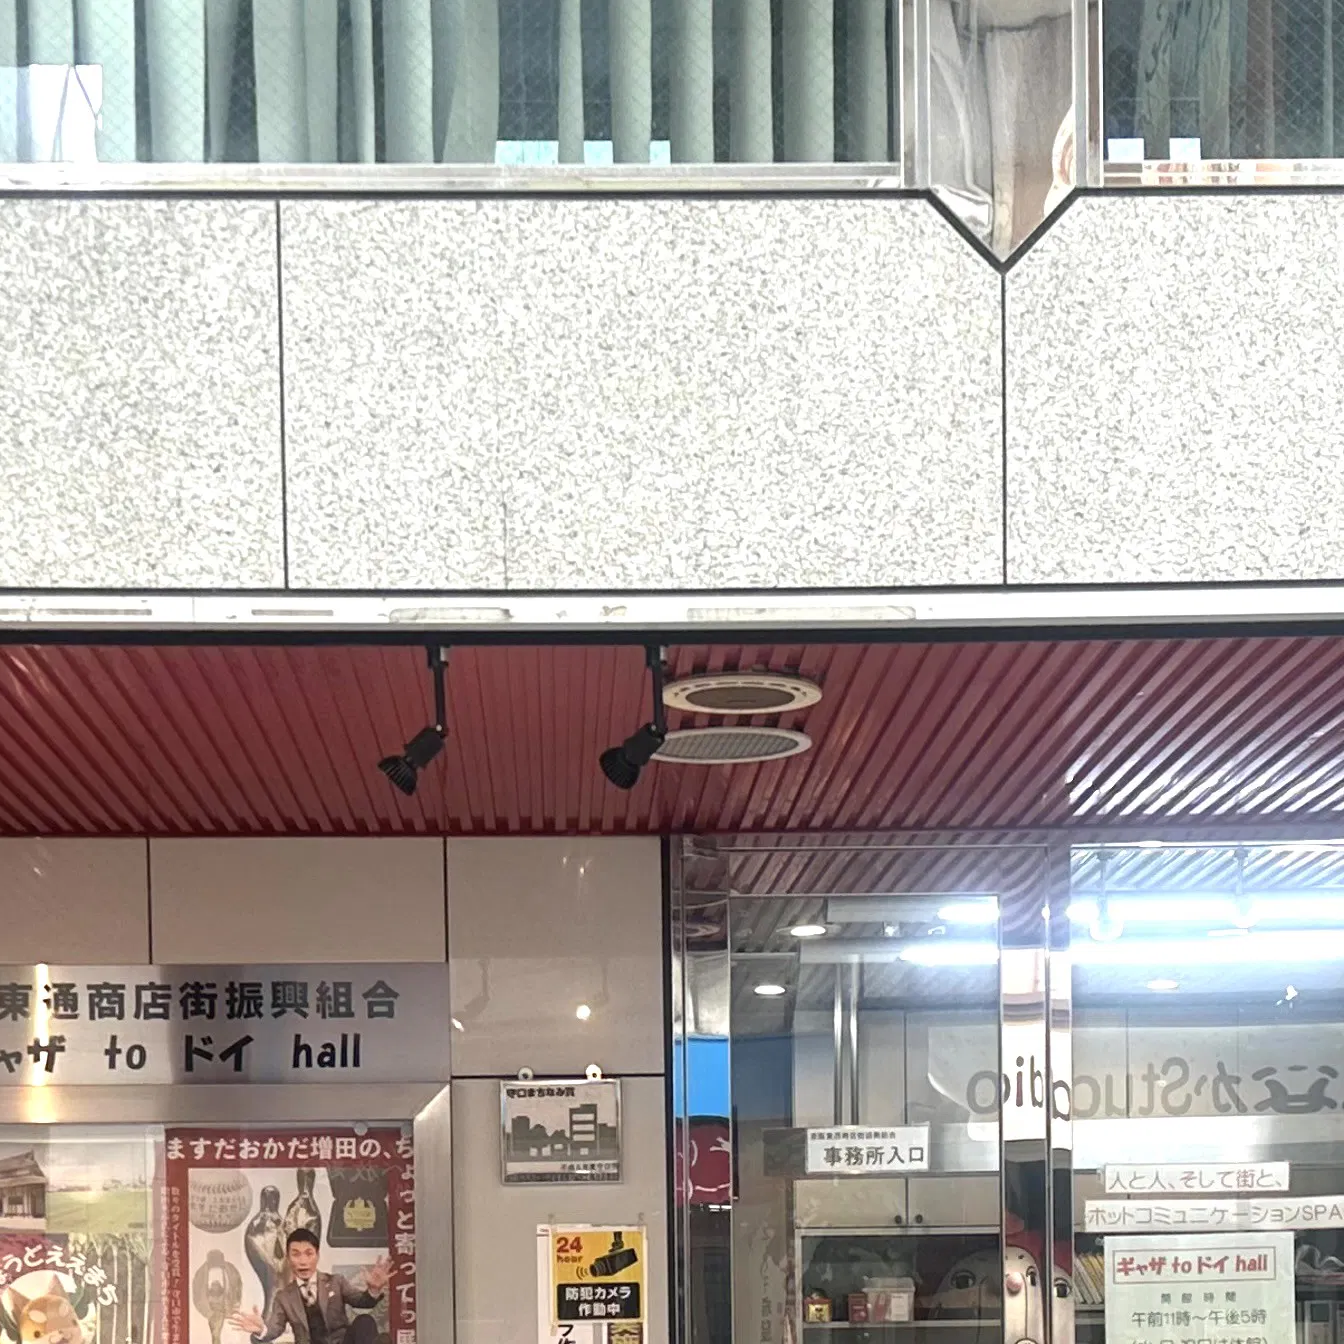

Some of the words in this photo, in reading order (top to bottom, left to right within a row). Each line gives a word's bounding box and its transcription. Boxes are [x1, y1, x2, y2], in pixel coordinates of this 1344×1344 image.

[104, 1035, 147, 1069] to
[185, 1035, 254, 1072] ドイ
[292, 1033, 361, 1069] hall
[166, 1137, 391, 1161] ますだおかだ増田の、
[824, 1146, 924, 1167] 事務所入口
[1109, 1168, 1283, 1190] 人と人、そして街と、
[557, 1236, 584, 1253] 24
[557, 1254, 584, 1263] hour
[1116, 1258, 1166, 1276] ギャザ
[1172, 1257, 1192, 1273] to
[1197, 1256, 1230, 1273] ドイ
[1235, 1254, 1268, 1272] hall
[565, 1287, 631, 1300] 防犯カメラ
[579, 1303, 621, 1316] 作動中
